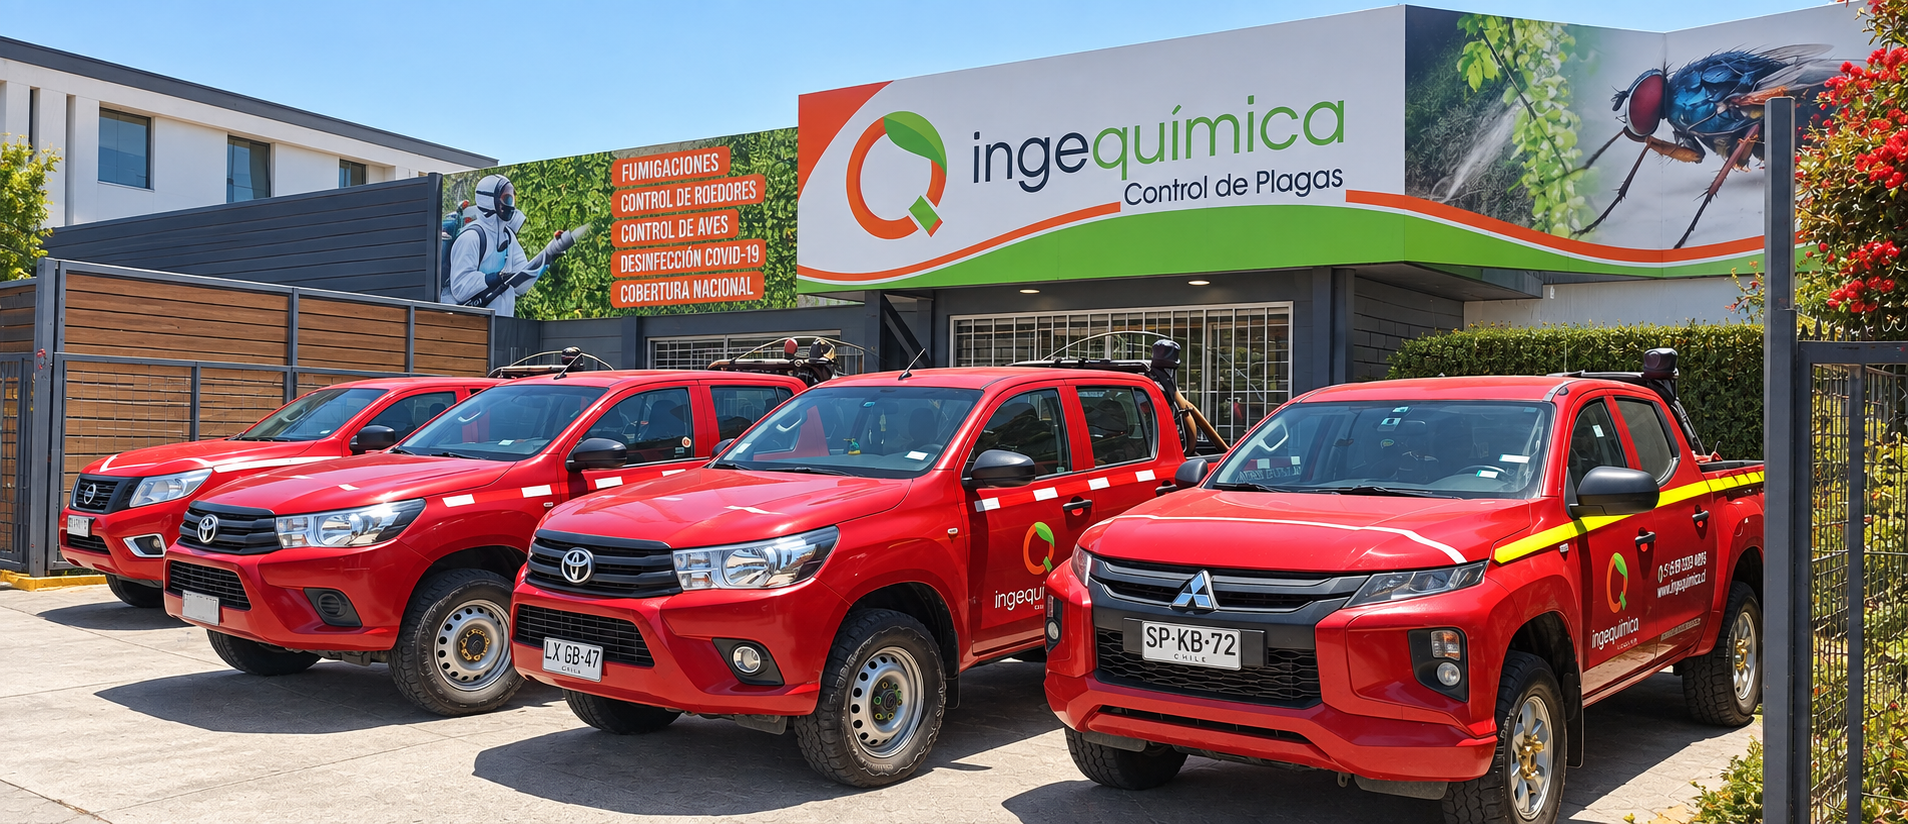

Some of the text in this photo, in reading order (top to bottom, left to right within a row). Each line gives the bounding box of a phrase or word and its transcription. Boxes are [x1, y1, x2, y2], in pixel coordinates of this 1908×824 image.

[972, 94, 1345, 193] ingequímica
[621, 153, 719, 182] FUMIGACIONES
[620, 179, 757, 213] CONTROL DE ROEDORES
[1123, 167, 1344, 206] Control de Plagas
[620, 214, 729, 243] CONTROL DE AVES
[620, 243, 760, 273] DESINFECCIÓN COVID-19
[620, 276, 754, 303] COBERTURA NACIONAL
[995, 581, 1045, 611] ingequi
[545, 641, 561, 661] LX
[1174, 653, 1206, 663] CHILE
